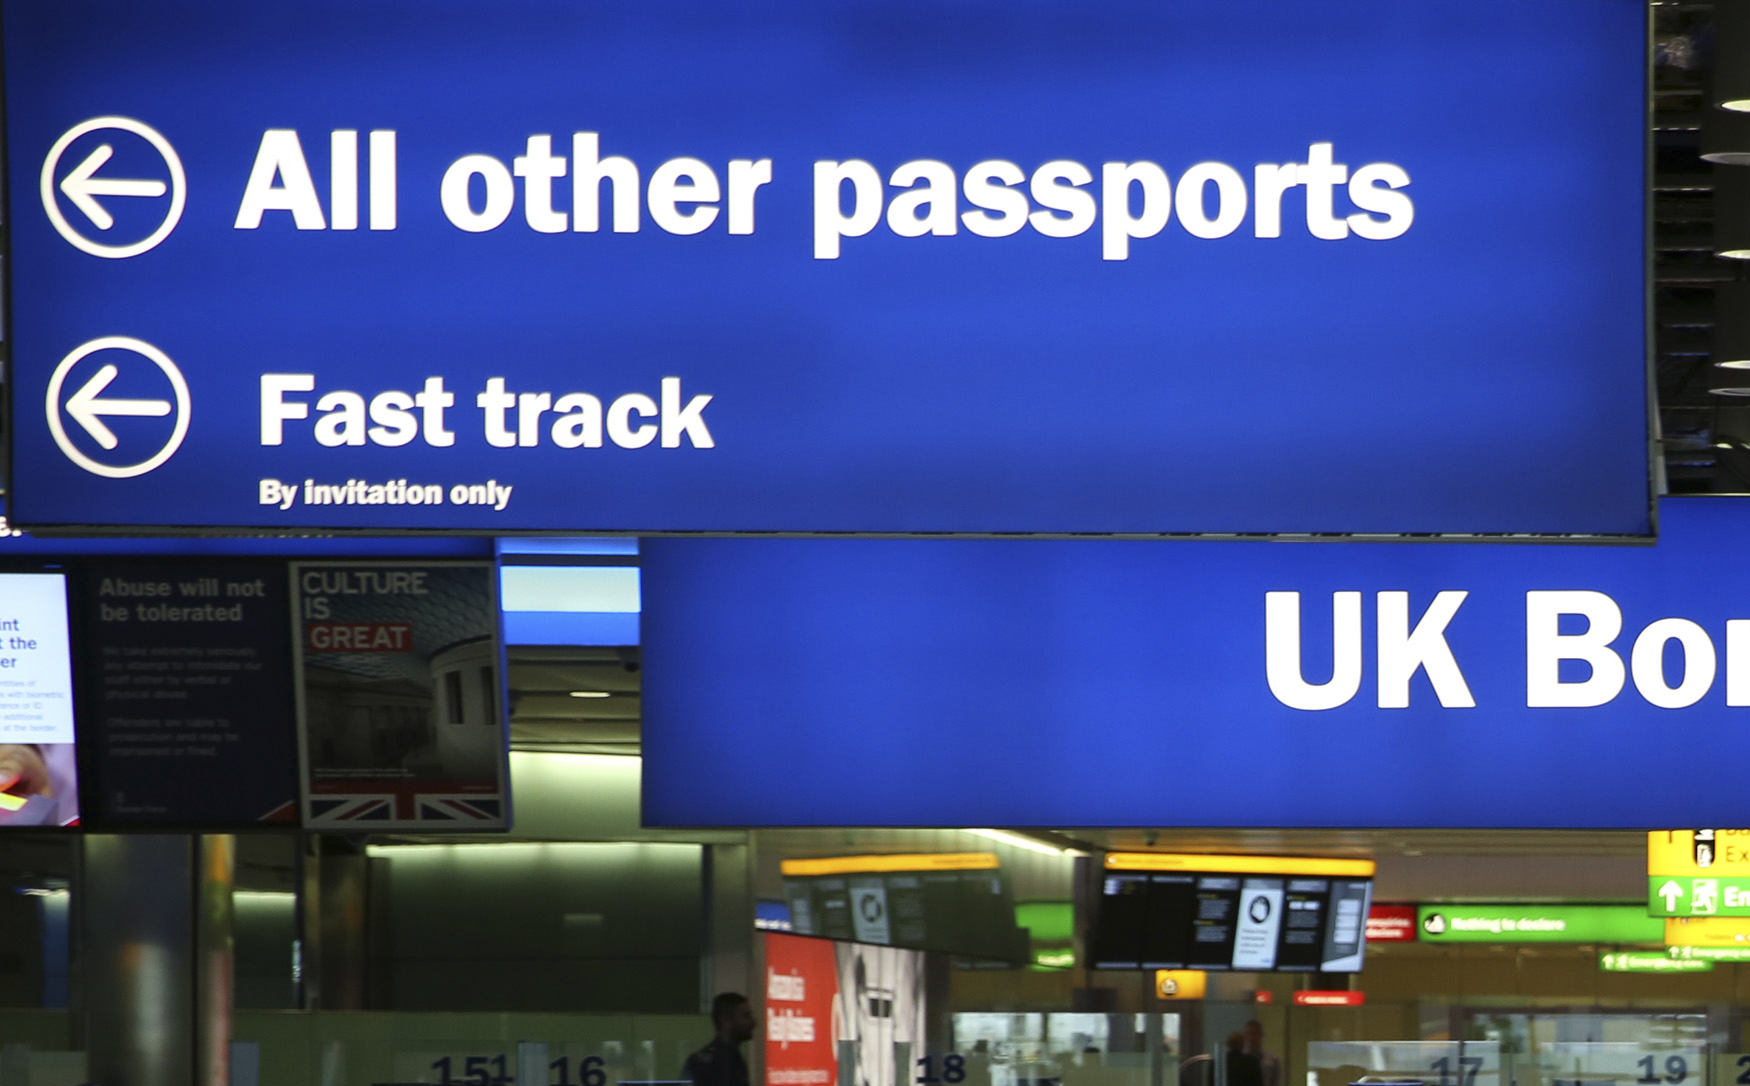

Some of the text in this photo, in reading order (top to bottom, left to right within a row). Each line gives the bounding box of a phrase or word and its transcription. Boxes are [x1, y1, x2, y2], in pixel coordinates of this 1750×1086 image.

[234, 129, 1414, 260] All other passports
[261, 374, 715, 449] Fast track
[260, 479, 512, 511] By invitation only
[99, 577, 265, 597] Abuse will not
[302, 571, 429, 595] CULTURE
[100, 603, 243, 622] be tolerated
[304, 597, 331, 620] IS
[10, 637, 37, 650] the
[310, 626, 409, 649] GREAT
[1266, 591, 1476, 711] UK
[916, 1053, 966, 1084] 18
[1637, 1054, 1688, 1085] 19
